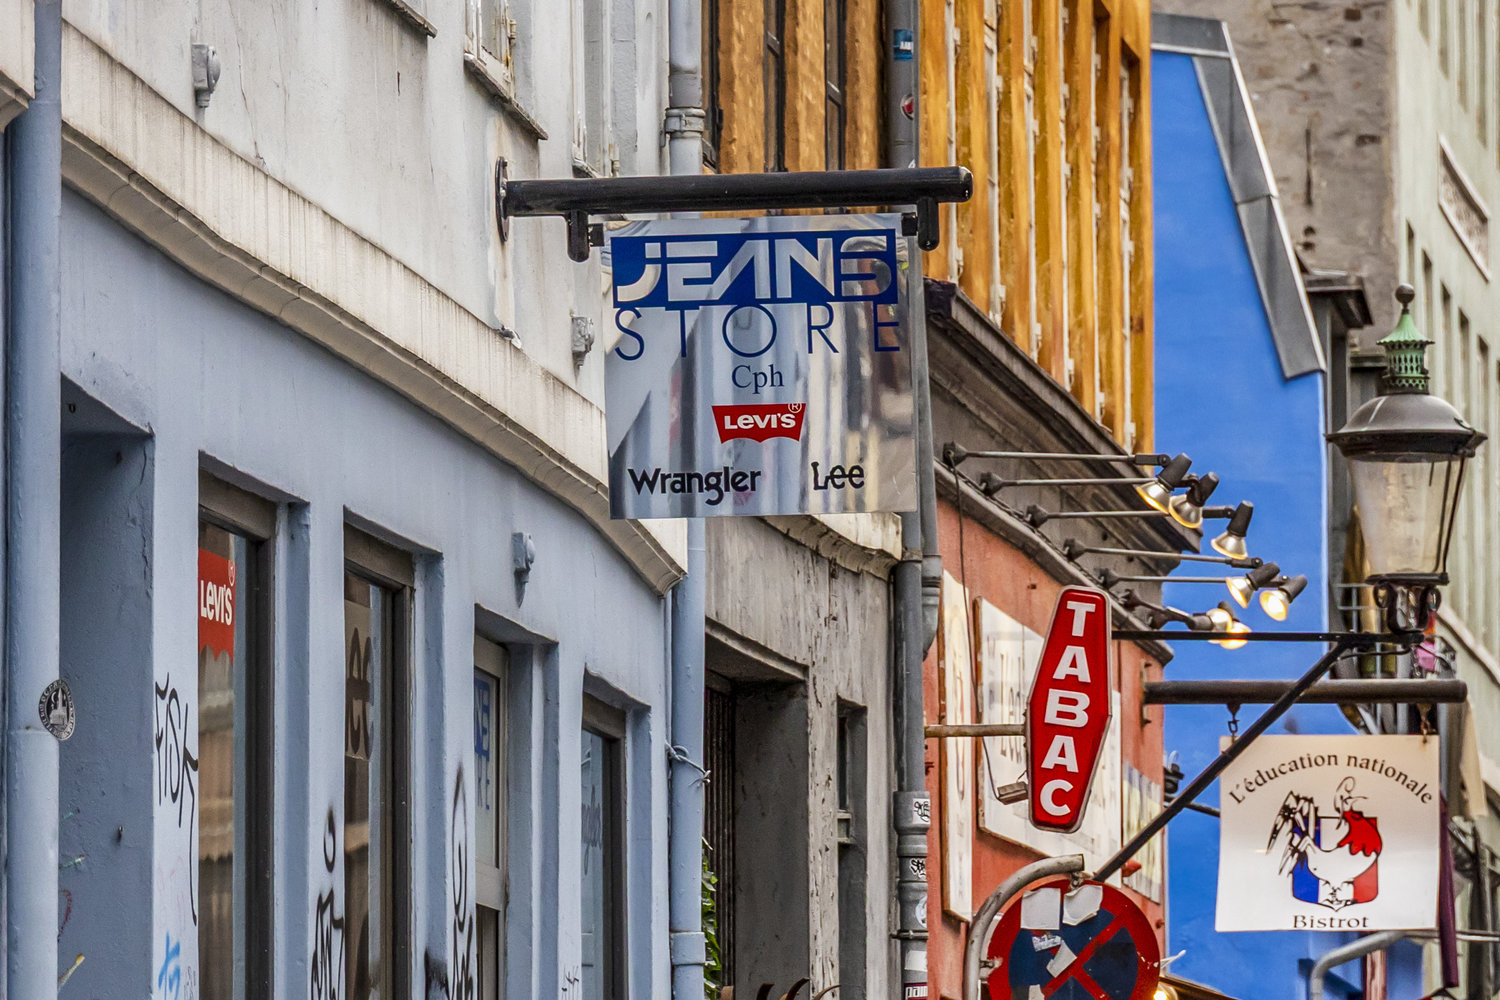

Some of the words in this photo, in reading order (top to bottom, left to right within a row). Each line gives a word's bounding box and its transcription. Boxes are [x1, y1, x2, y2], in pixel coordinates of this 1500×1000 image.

[617, 235, 892, 302] JEANS
[615, 302, 900, 361] STORE
[731, 364, 784, 394] Cph
[628, 466, 762, 505] Wrangler
[811, 462, 865, 491] Lee
[1040, 600, 1096, 816] TABAC
[1229, 753, 1339, 805] L'éducation
[1346, 754, 1433, 804] nationale
[1292, 914, 1369, 929] Bistrot
